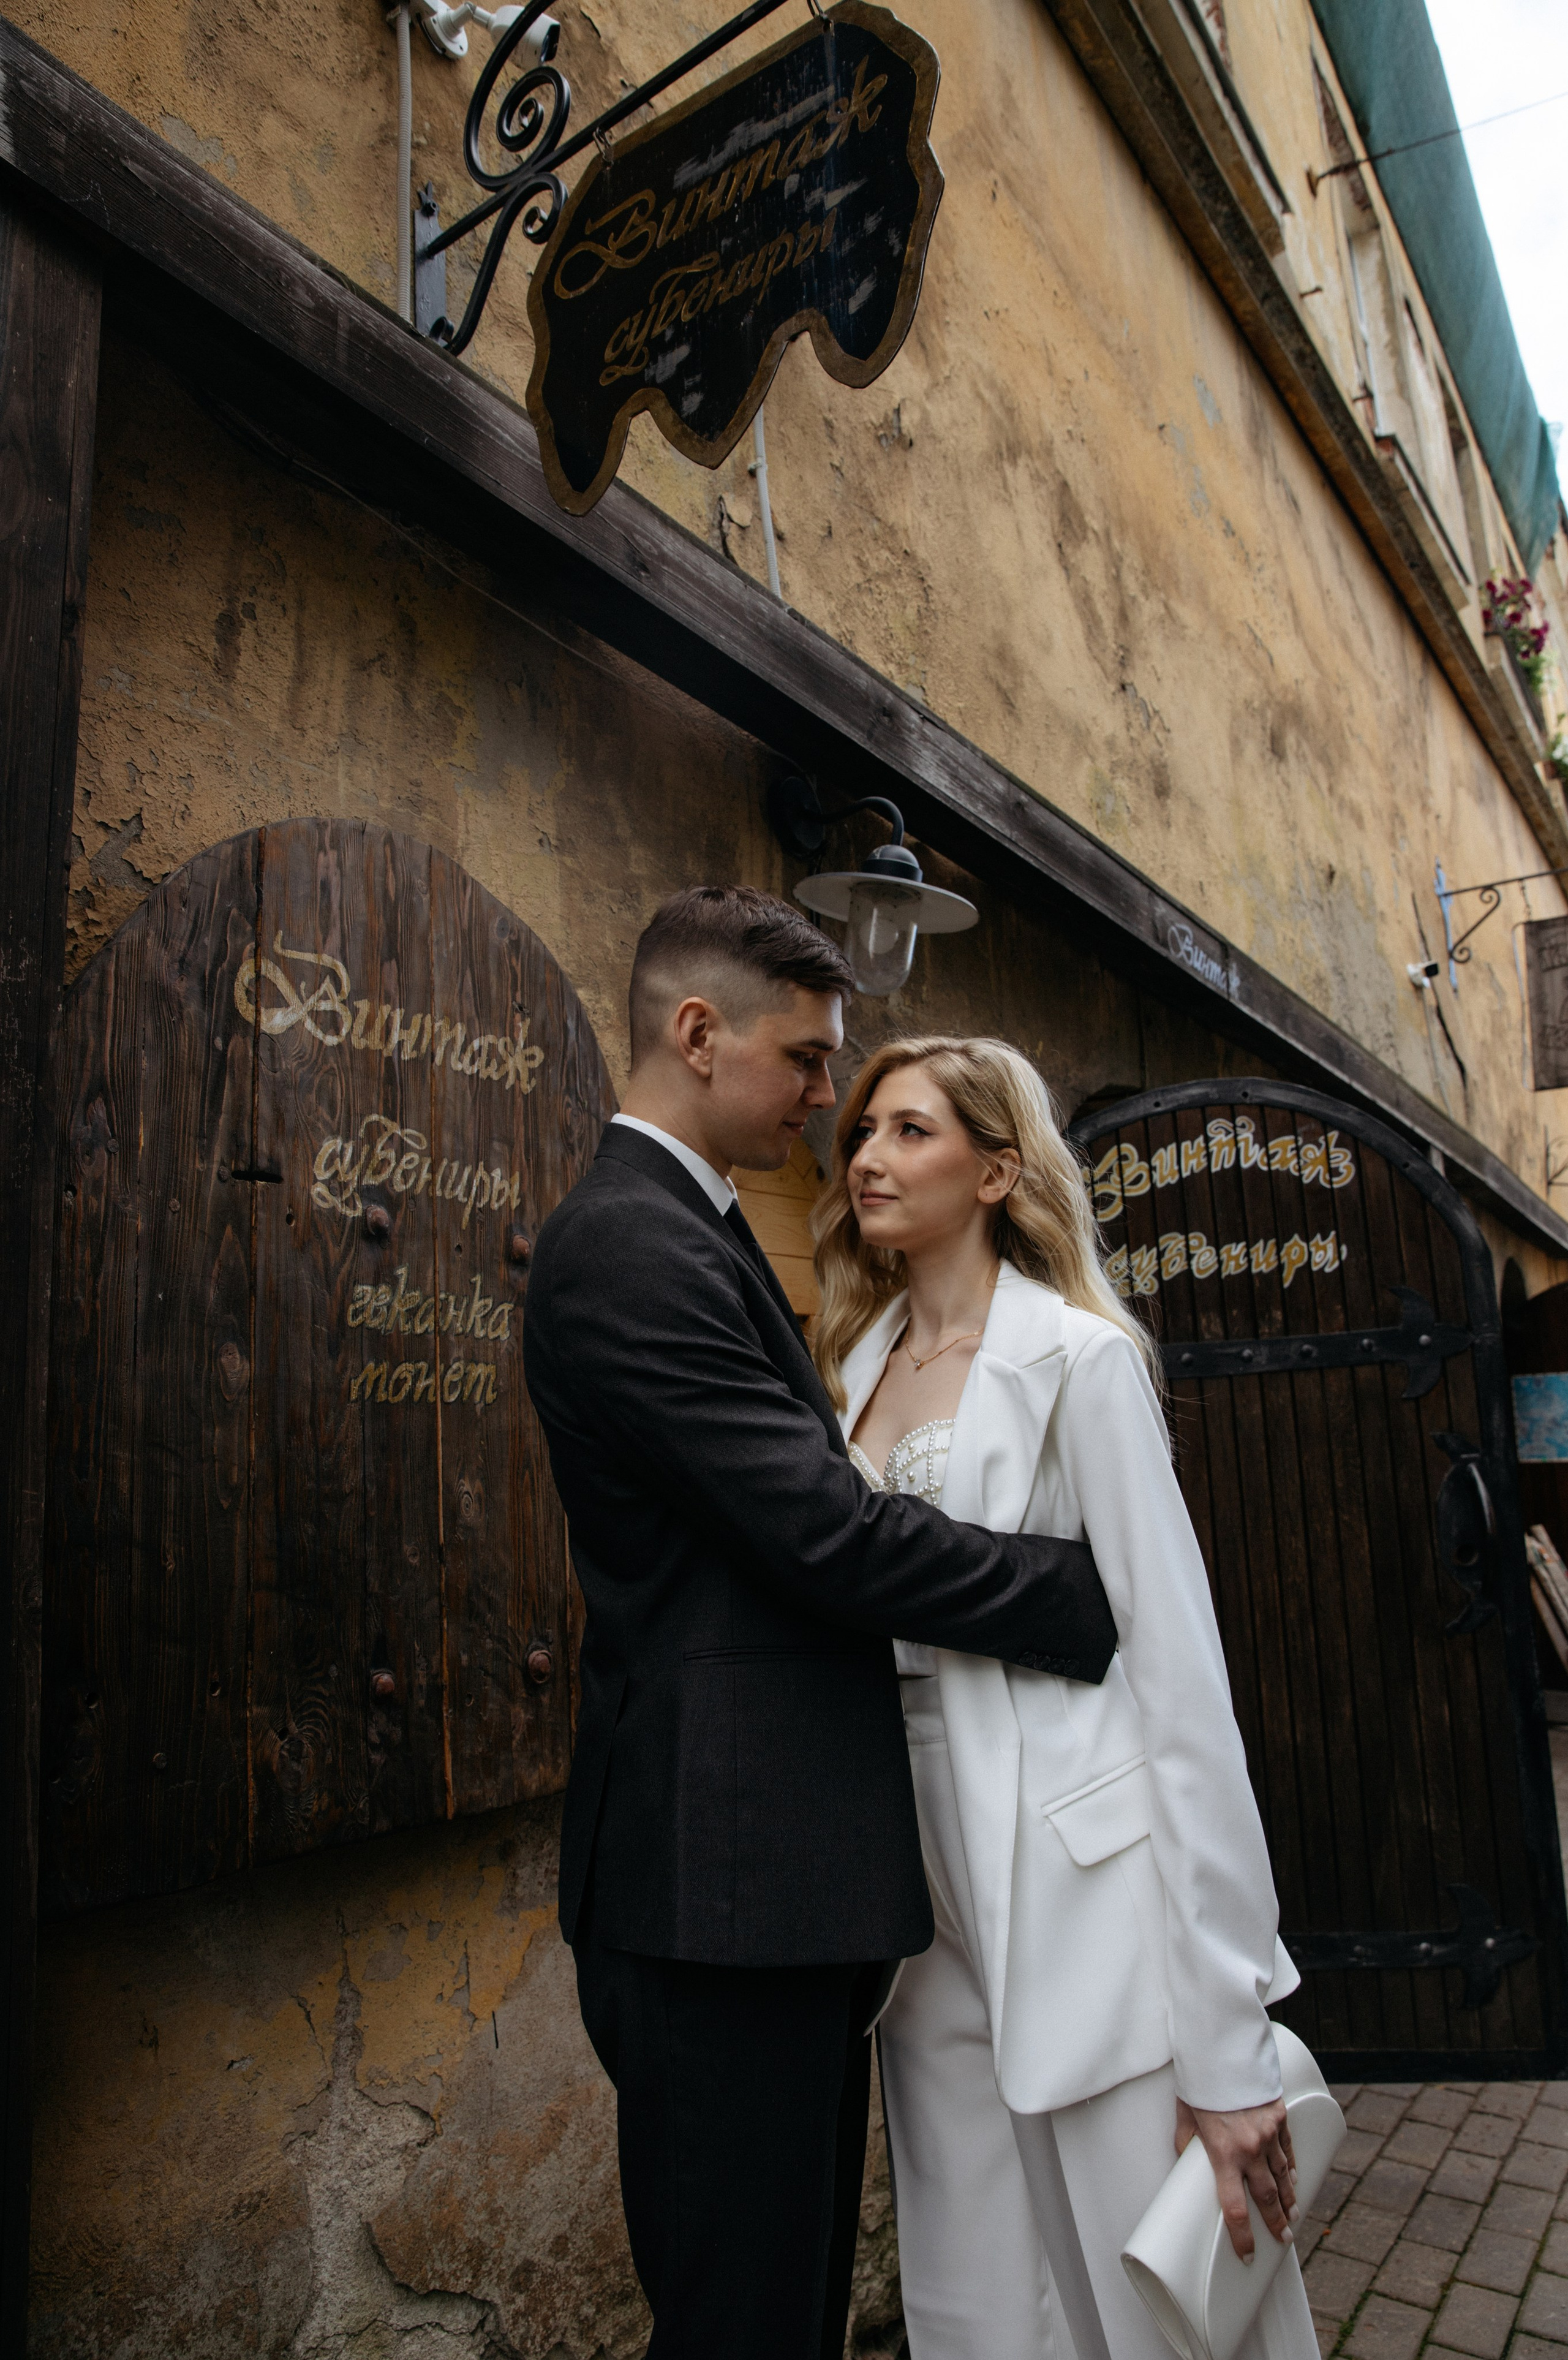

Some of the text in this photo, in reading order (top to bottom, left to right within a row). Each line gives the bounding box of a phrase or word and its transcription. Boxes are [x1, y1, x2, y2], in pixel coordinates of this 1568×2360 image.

[555, 55, 888, 299] Винтаж
[599, 208, 837, 386] сувениры
[234, 930, 545, 1095] Винтаж
[310, 1113, 522, 1230] сувениры
[1082, 1116, 1355, 1222] Винтаж
[1104, 1230, 1348, 1298] сувениры
[350, 1360, 498, 1404] монет
